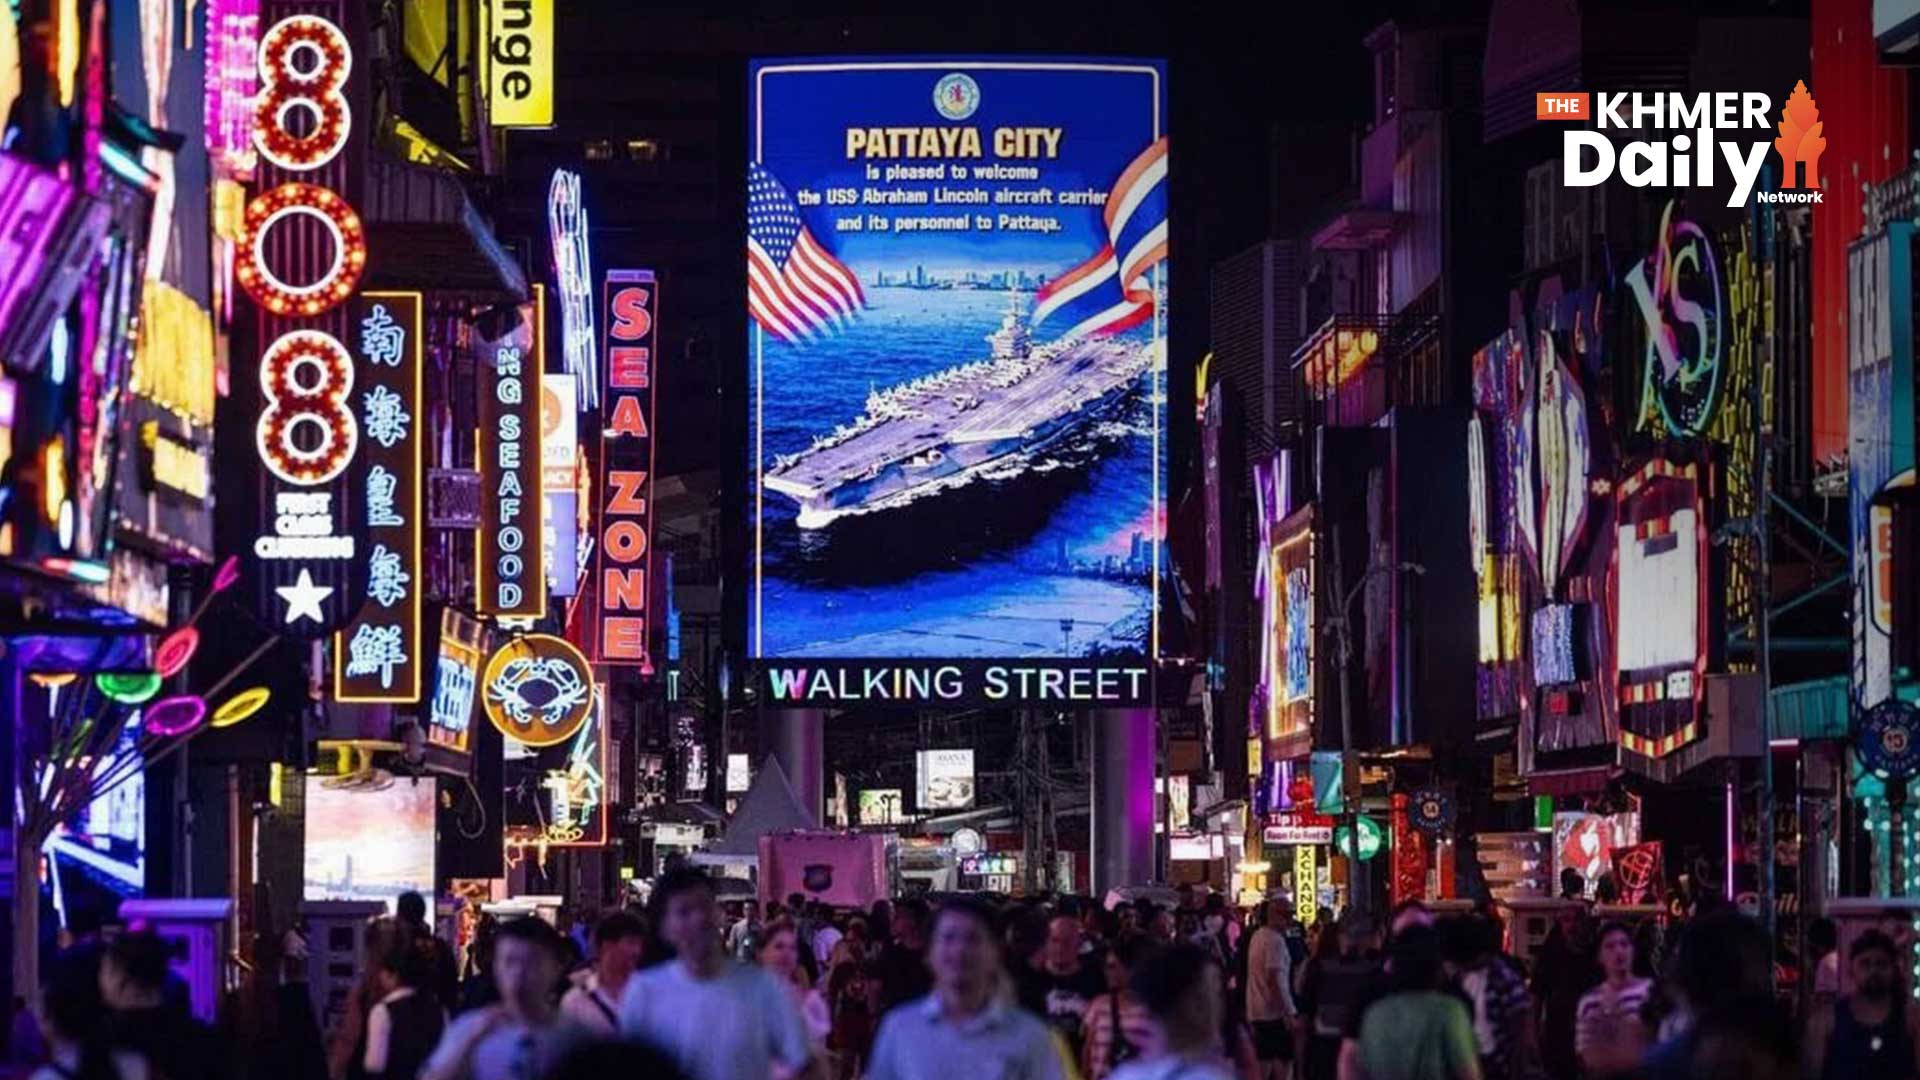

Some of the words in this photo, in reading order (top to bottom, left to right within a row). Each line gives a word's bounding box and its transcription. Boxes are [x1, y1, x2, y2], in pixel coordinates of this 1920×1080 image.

[846, 127, 982, 158] PATTAYA
[993, 127, 1062, 158] CITY
[866, 164, 880, 179] is
[886, 164, 944, 182] pleased
[951, 165, 967, 179] to
[974, 164, 1038, 180] welcome
[798, 188, 820, 205] the
[863, 188, 927, 204] Abraham
[934, 188, 988, 204] Lincoln
[995, 187, 1053, 204] aircraft
[1059, 188, 1107, 205] carrier
[836, 215, 862, 231] and
[868, 215, 889, 231] its
[895, 214, 970, 233] personnel
[976, 215, 992, 230] to
[999, 214, 1062, 233] Pattaya.
[609, 287, 651, 438] SEA
[497, 413, 523, 608] SEAFOOD
[603, 471, 648, 659] ZONE
[769, 667, 963, 700] WALKING
[984, 667, 1147, 700] STREET
